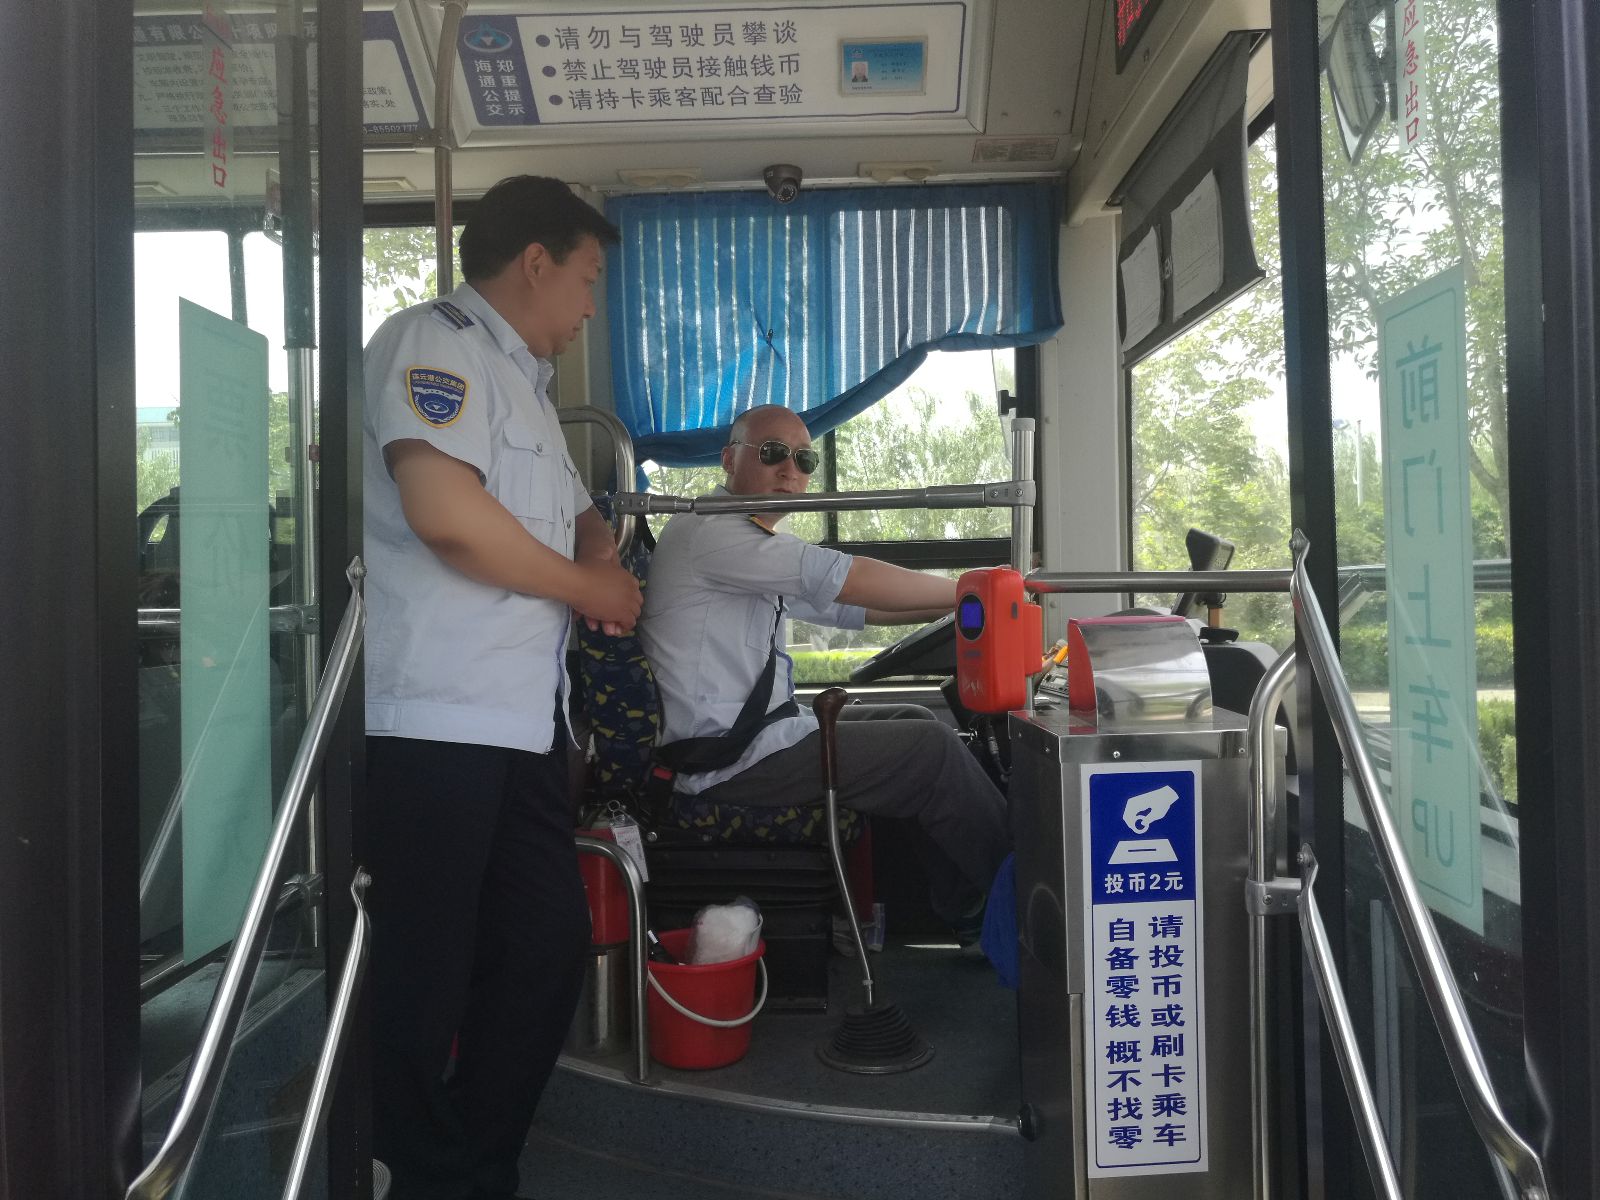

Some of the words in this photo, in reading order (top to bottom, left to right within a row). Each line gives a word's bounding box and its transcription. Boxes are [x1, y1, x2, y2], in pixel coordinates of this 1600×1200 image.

[554, 20, 798, 49] 请勿与驾驶员攀谈
[474, 59, 505, 116] 海通公交
[496, 58, 526, 115] 郑重提示
[562, 53, 801, 83] 禁止驾驶员接触钱币
[1402, 0, 1419, 145] 应急出口
[568, 84, 804, 111] 请持卡乘客配合查验
[1104, 872, 1184, 894] 投币2元
[1105, 918, 1141, 1029] 自备零钱
[1148, 915, 1187, 1147] 请投币或刷卡乘车
[1105, 1040, 1143, 1150] 概不找零
